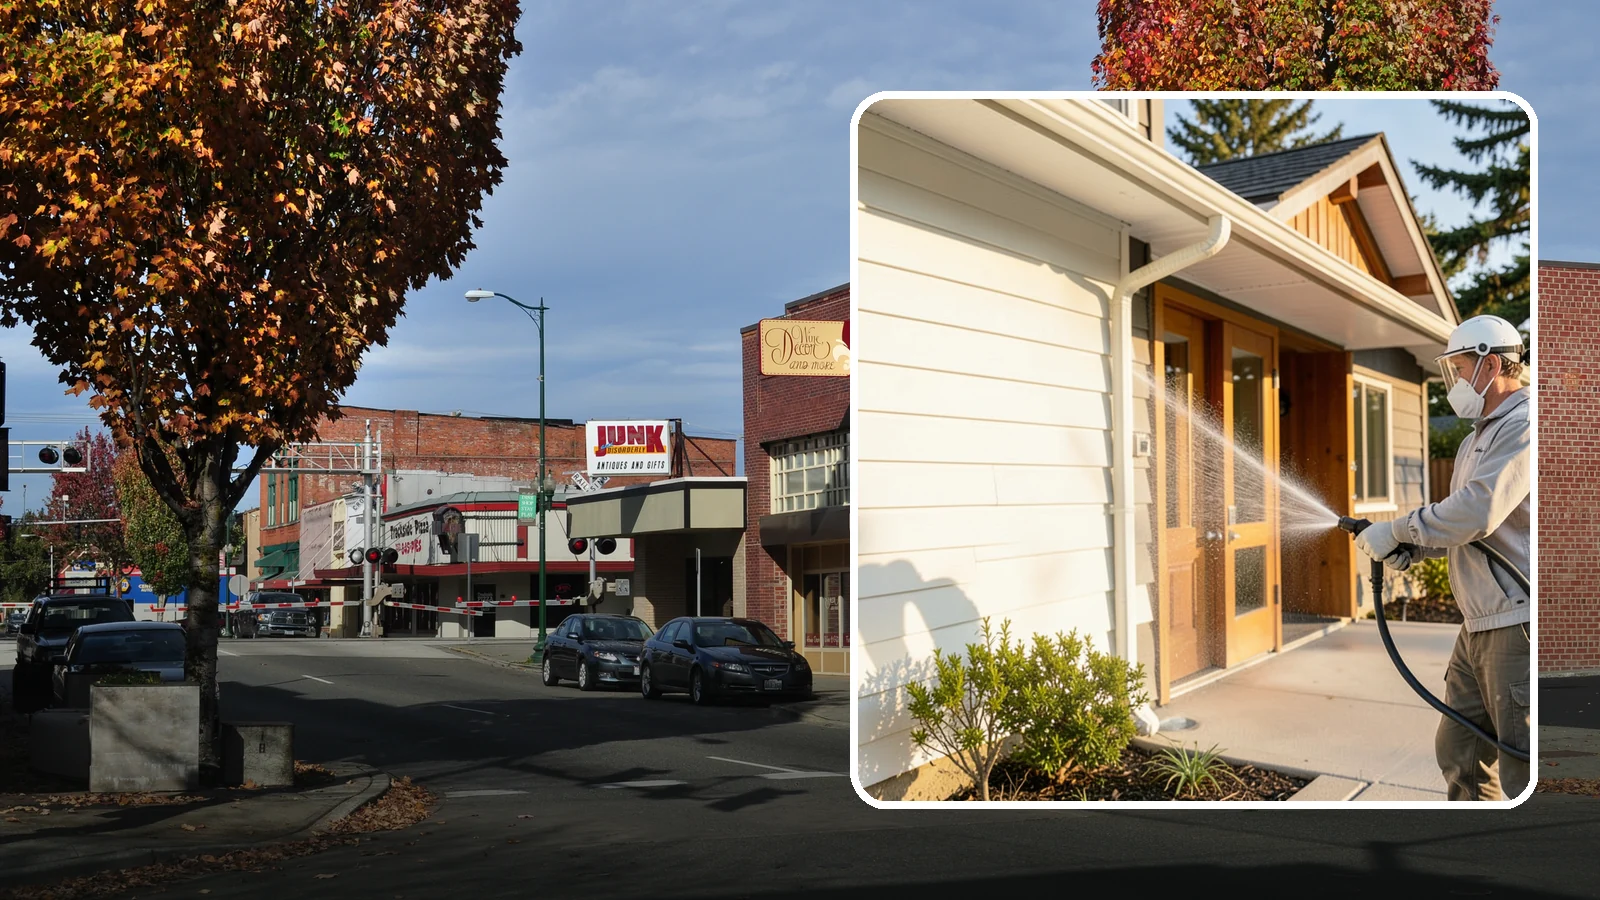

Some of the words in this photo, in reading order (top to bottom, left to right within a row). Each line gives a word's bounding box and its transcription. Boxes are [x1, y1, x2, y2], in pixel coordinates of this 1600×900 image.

[595, 425, 666, 456] JUNK
[607, 446, 646, 454] DISORDERLY
[596, 461, 628, 470] ANTIQUES
[631, 460, 644, 470] AND
[646, 460, 665, 470] GIFTS
[390, 521, 413, 540] Trackside
[414, 519, 429, 535] Pizza
